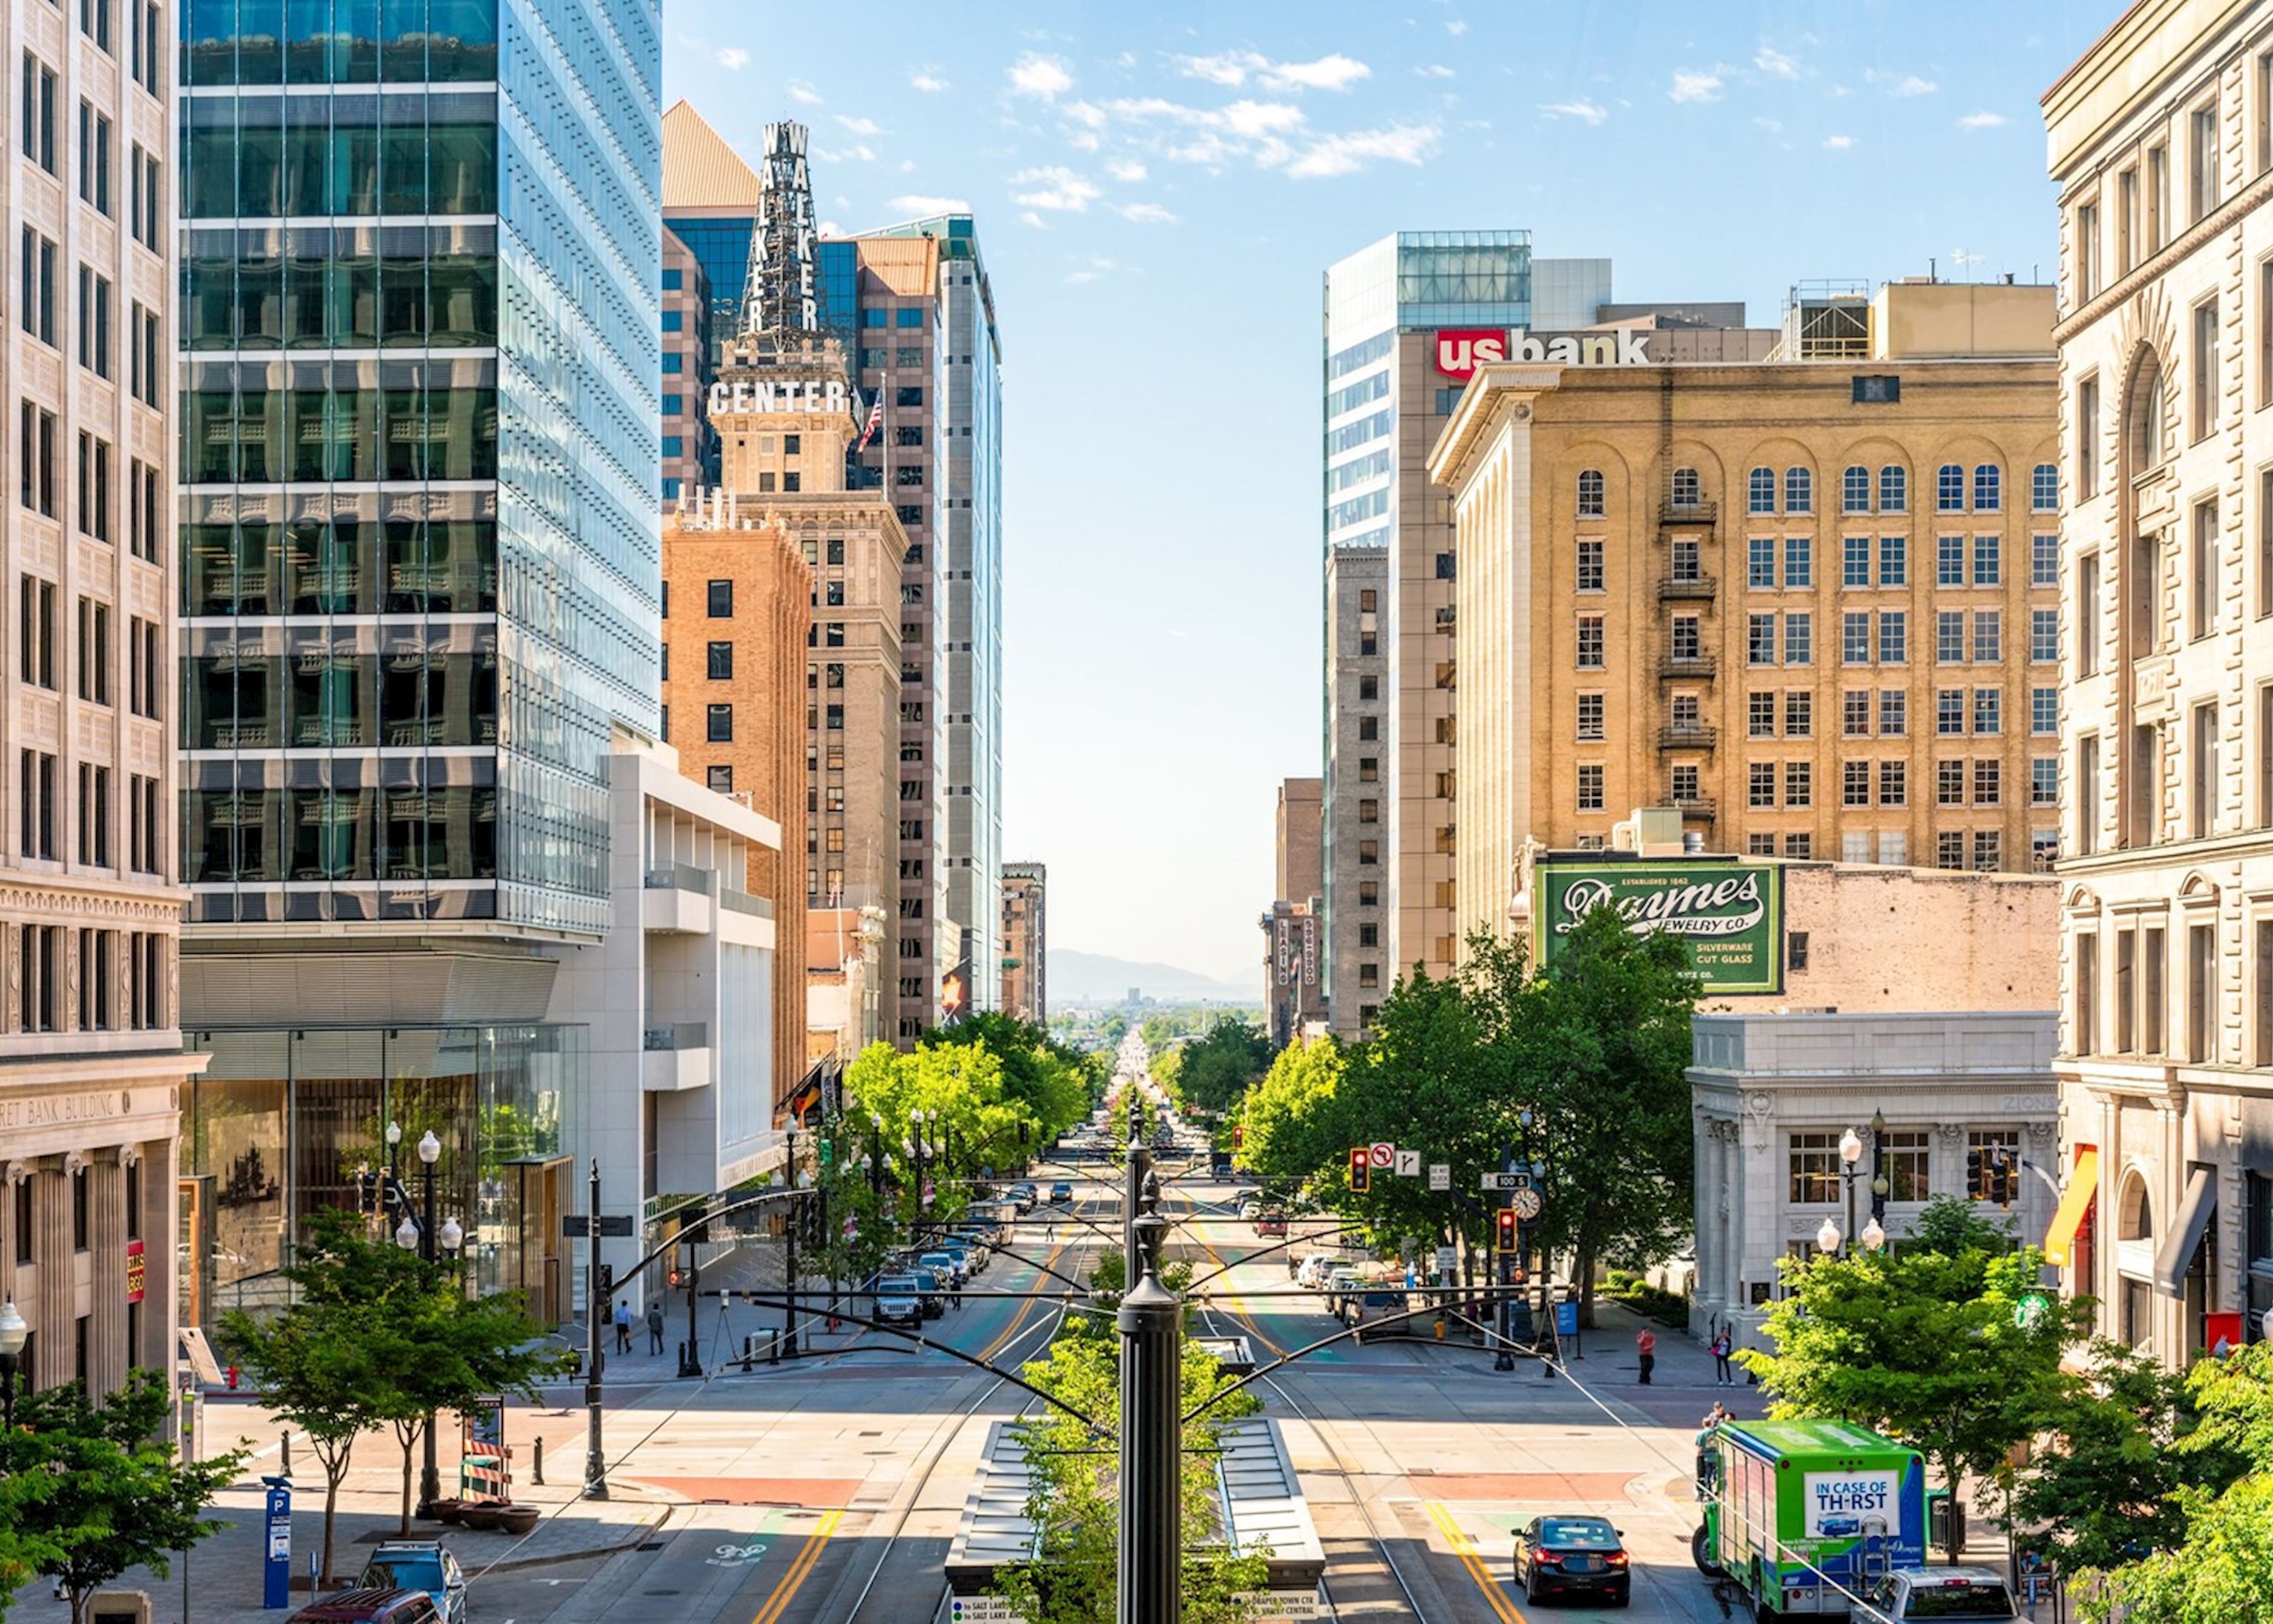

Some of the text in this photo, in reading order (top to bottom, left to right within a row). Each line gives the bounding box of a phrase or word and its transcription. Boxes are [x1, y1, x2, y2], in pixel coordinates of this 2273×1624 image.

[749, 123, 779, 333] WALKER
[789, 124, 817, 332] WALKER
[1439, 328, 1650, 372] us bank
[710, 381, 845, 415] CENTER
[1658, 917, 1748, 932] JEWELRY CO.
[1696, 942, 1754, 952] SILVERWARE
[1696, 954, 1753, 964] CUT GLASS
[28, 1098, 59, 1124] BANK
[65, 1094, 114, 1120] BUILDING
[2004, 1096, 2055, 1110] ZIONS
[1500, 1177, 1515, 1186] 100
[1816, 1481, 1887, 1494] IN CASE OF
[274, 1499, 285, 1512] P
